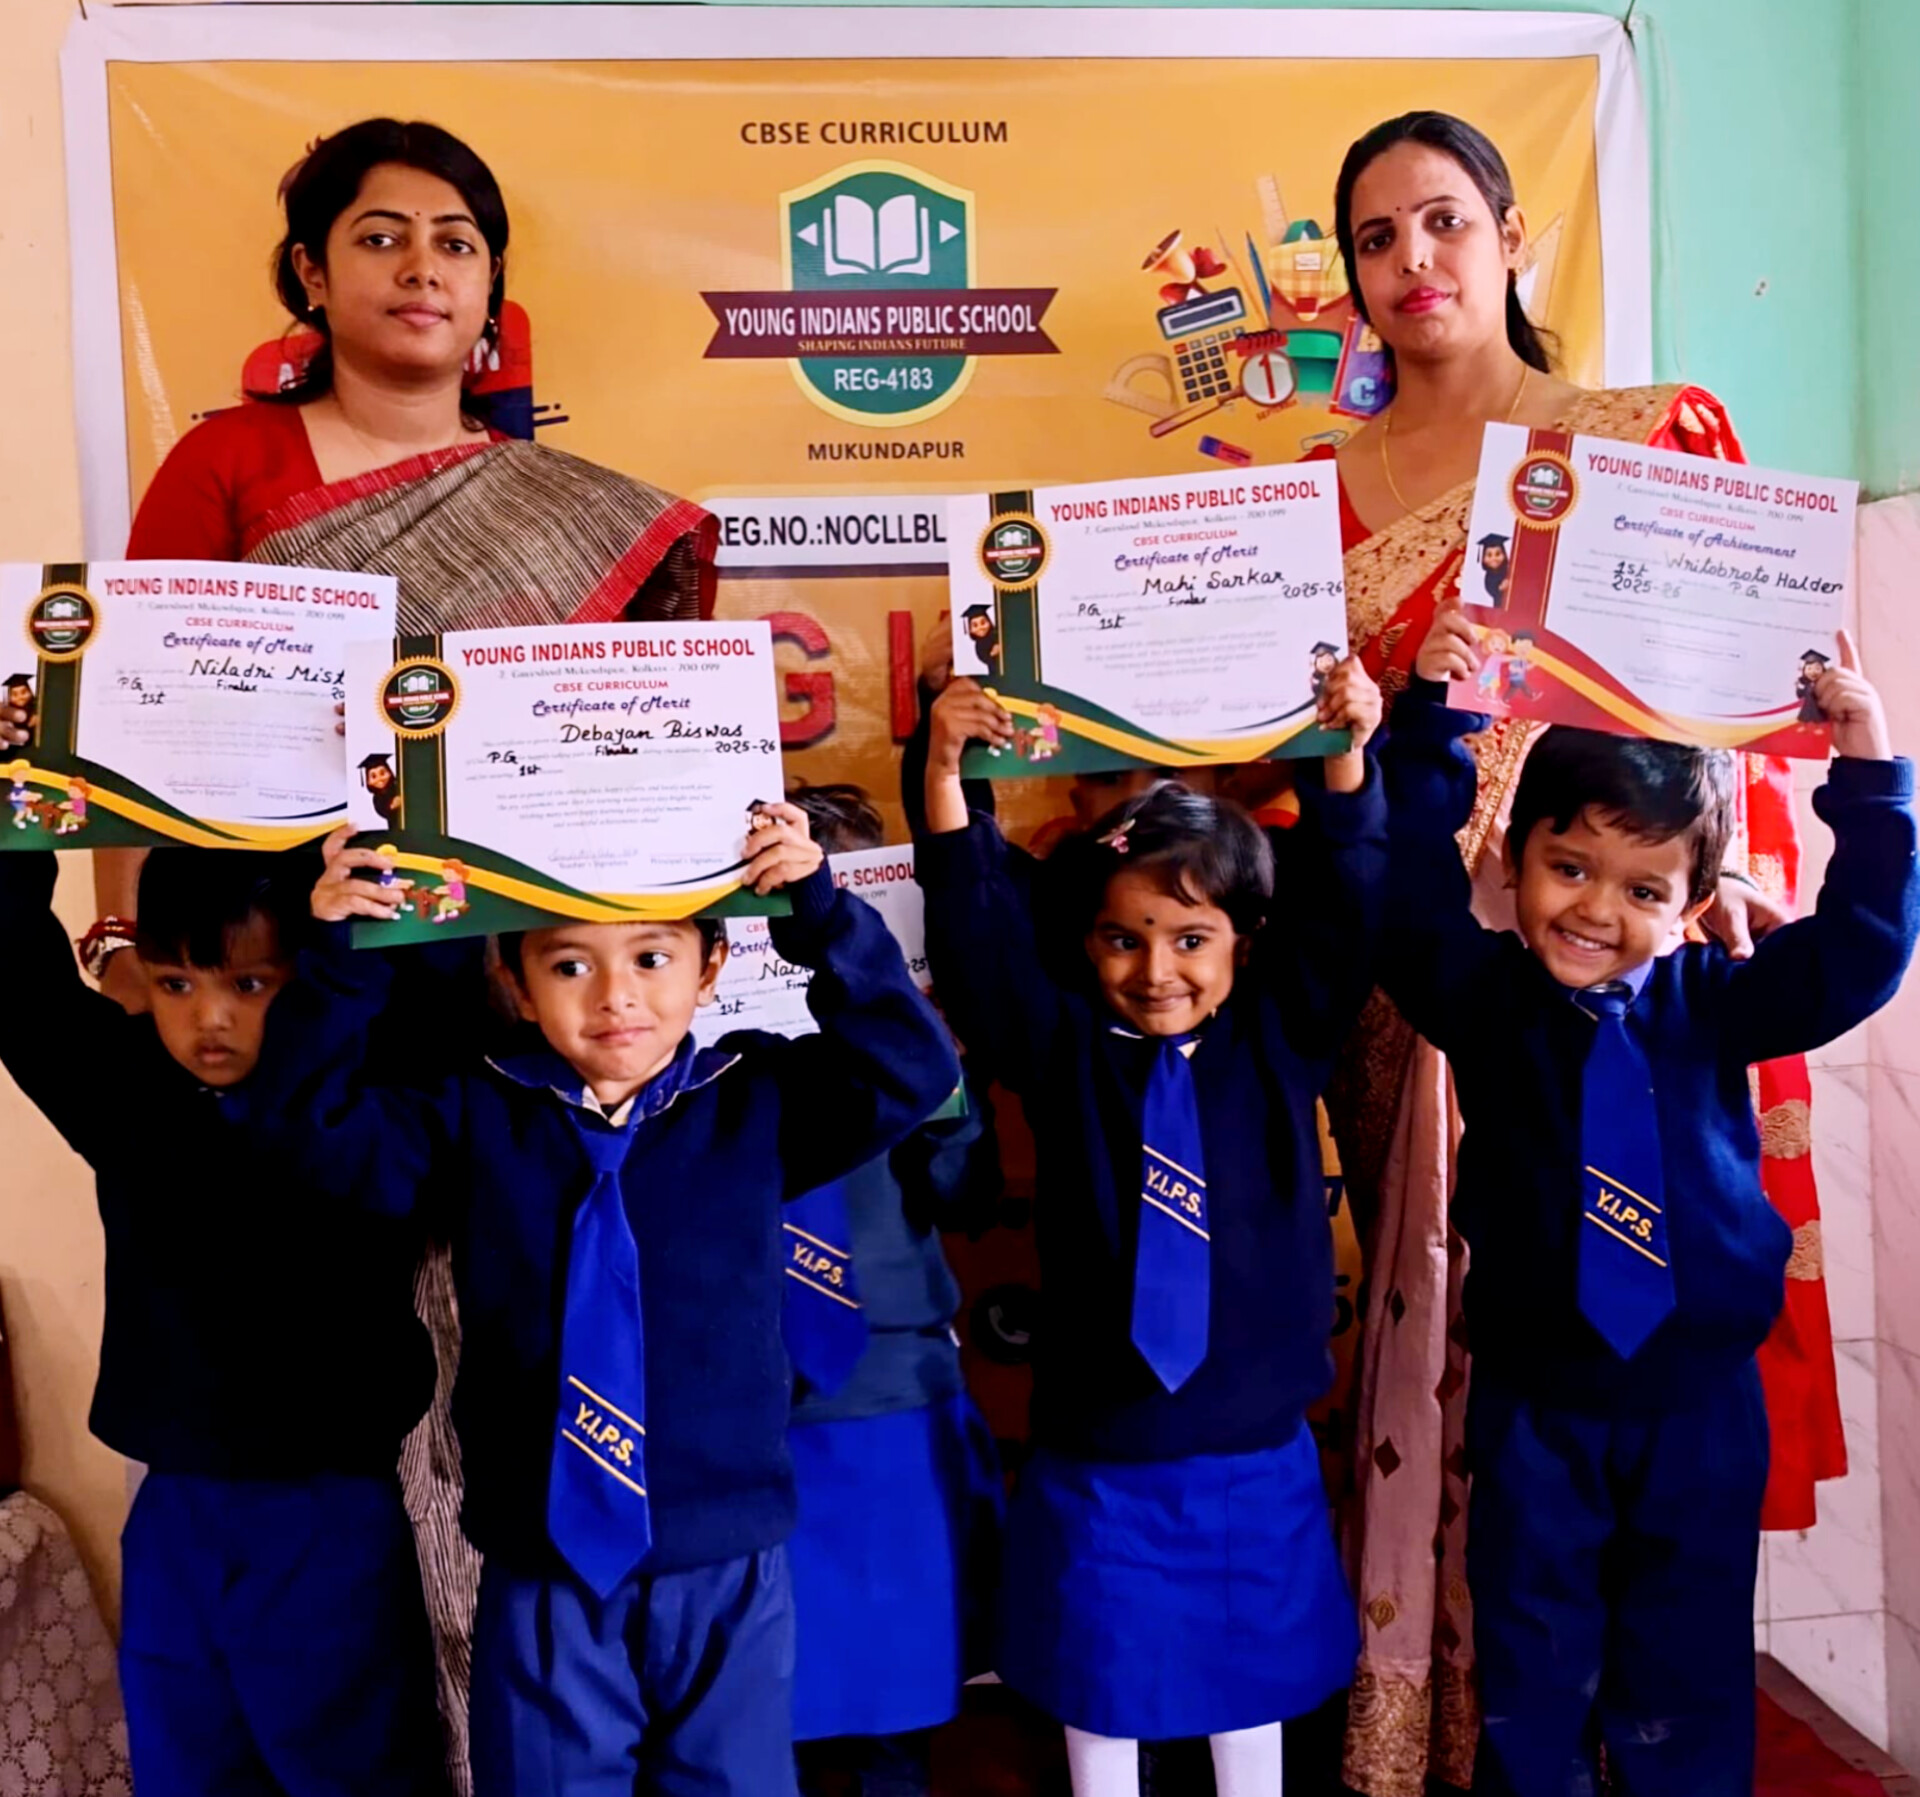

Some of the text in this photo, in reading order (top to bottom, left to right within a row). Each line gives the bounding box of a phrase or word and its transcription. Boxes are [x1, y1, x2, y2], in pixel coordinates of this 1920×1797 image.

[741, 121, 1009, 144] CBSE CURRICULUM
[726, 304, 1037, 336] YOUNG INDIANS PUBLIC SCHOOL
[798, 338, 966, 352] SHAPING INDIANS FUTURE
[834, 368, 933, 391] REG-4183
[1350, 376, 1376, 407] C
[808, 441, 965, 461] MUKUNDAPUR
[1588, 453, 1839, 513] YOUNG INDIANS PUBLIC SCHOOL
[1051, 480, 1320, 522] YOUNG INDIANS PUBLIC SCHOOL
[1660, 506, 1756, 532] CBSE CURRICULUM
[1133, 529, 1238, 547] CBSE CURRICULUM
[1614, 514, 1797, 559] Certificate of Achievement
[1115, 545, 1258, 571] Certificate of Merit
[1613, 560, 1649, 577] 1st
[1142, 567, 1285, 596] Mahi Sarkar
[1281, 580, 1343, 599] 2025-26
[1776, 571, 1844, 594] Halder
[104, 578, 380, 609] YOUNG INDIANS PUBLIC SCHOOL
[186, 617, 294, 632] CBSE CURRICULUM
[1098, 614, 1126, 630] 1st
[163, 632, 314, 655] Certificate of Merit
[462, 638, 755, 667] YOUNG INDIANS PUBLIC SCHOOL
[678, 663, 698, 673] 700
[554, 680, 669, 692] CBSE CURRICULUM
[140, 691, 166, 705] 1st
[532, 695, 690, 718] Certificate of Merit
[560, 723, 654, 745] Debayan
[663, 719, 743, 738] Biswas
[713, 739, 776, 754] 2025-26
[519, 764, 541, 777] 1st
[853, 862, 914, 886] SCHOOL
[746, 922, 769, 933] CBS
[1146, 1165, 1202, 1218] Y.I.P.S.
[1596, 1187, 1653, 1242] Y.I.P.S.
[792, 1243, 844, 1287] Y.I.P.S.
[573, 1402, 635, 1467] Y.I.P.S.
